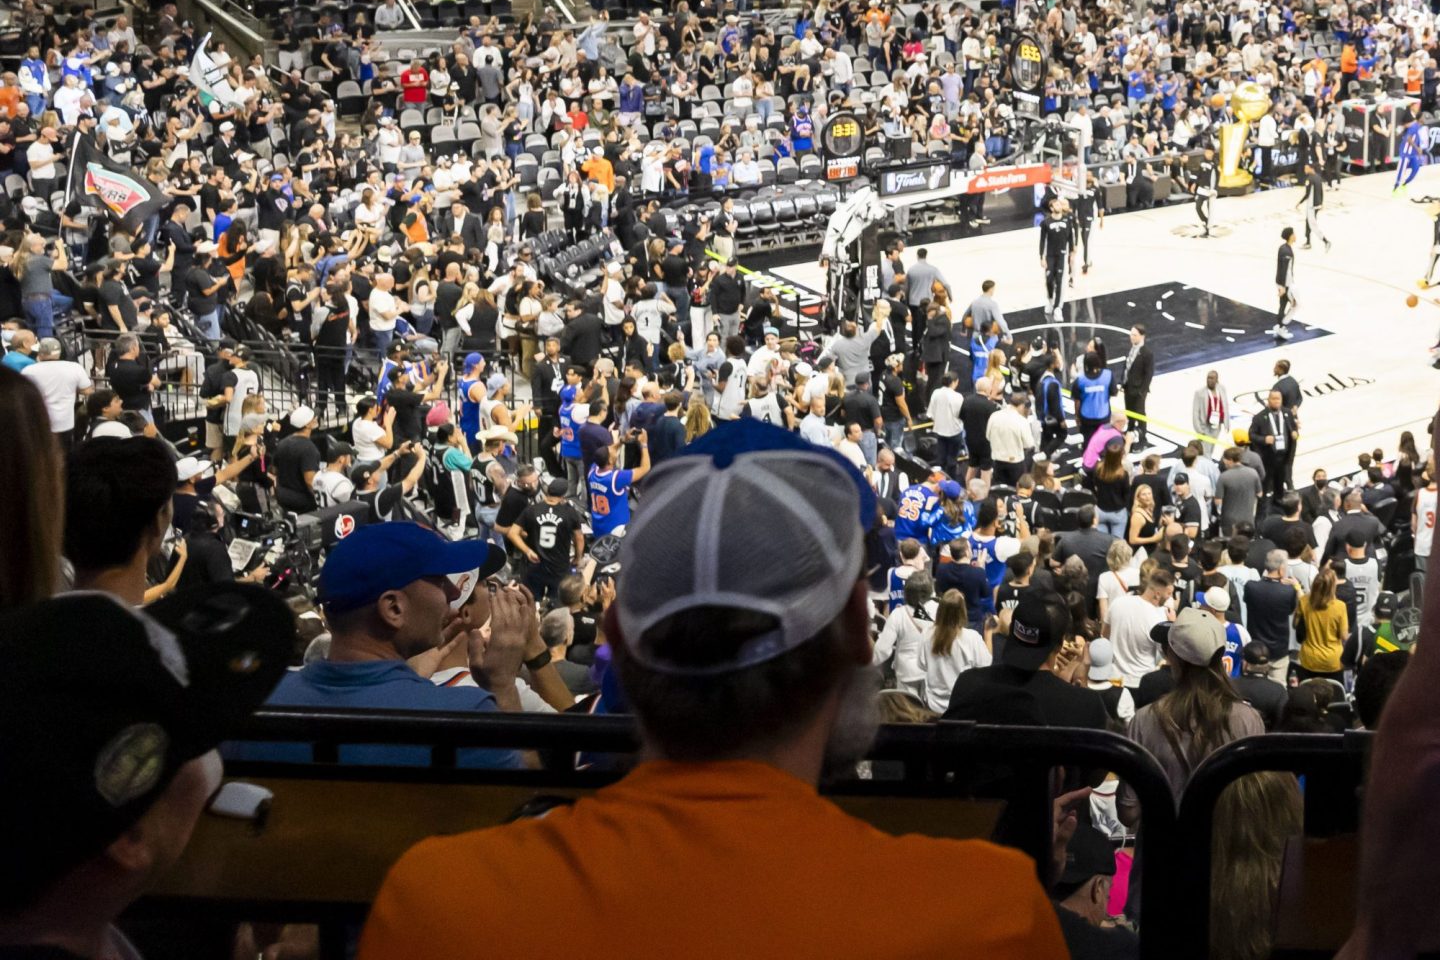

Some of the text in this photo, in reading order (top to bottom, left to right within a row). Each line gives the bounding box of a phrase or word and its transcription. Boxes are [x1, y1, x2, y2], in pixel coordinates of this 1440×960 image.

[832, 122, 857, 138] 13:33
[895, 172, 927, 193] Finals
[536, 513, 563, 526] CASTLE
[898, 497, 924, 522] 25
[539, 525, 557, 549] 5
